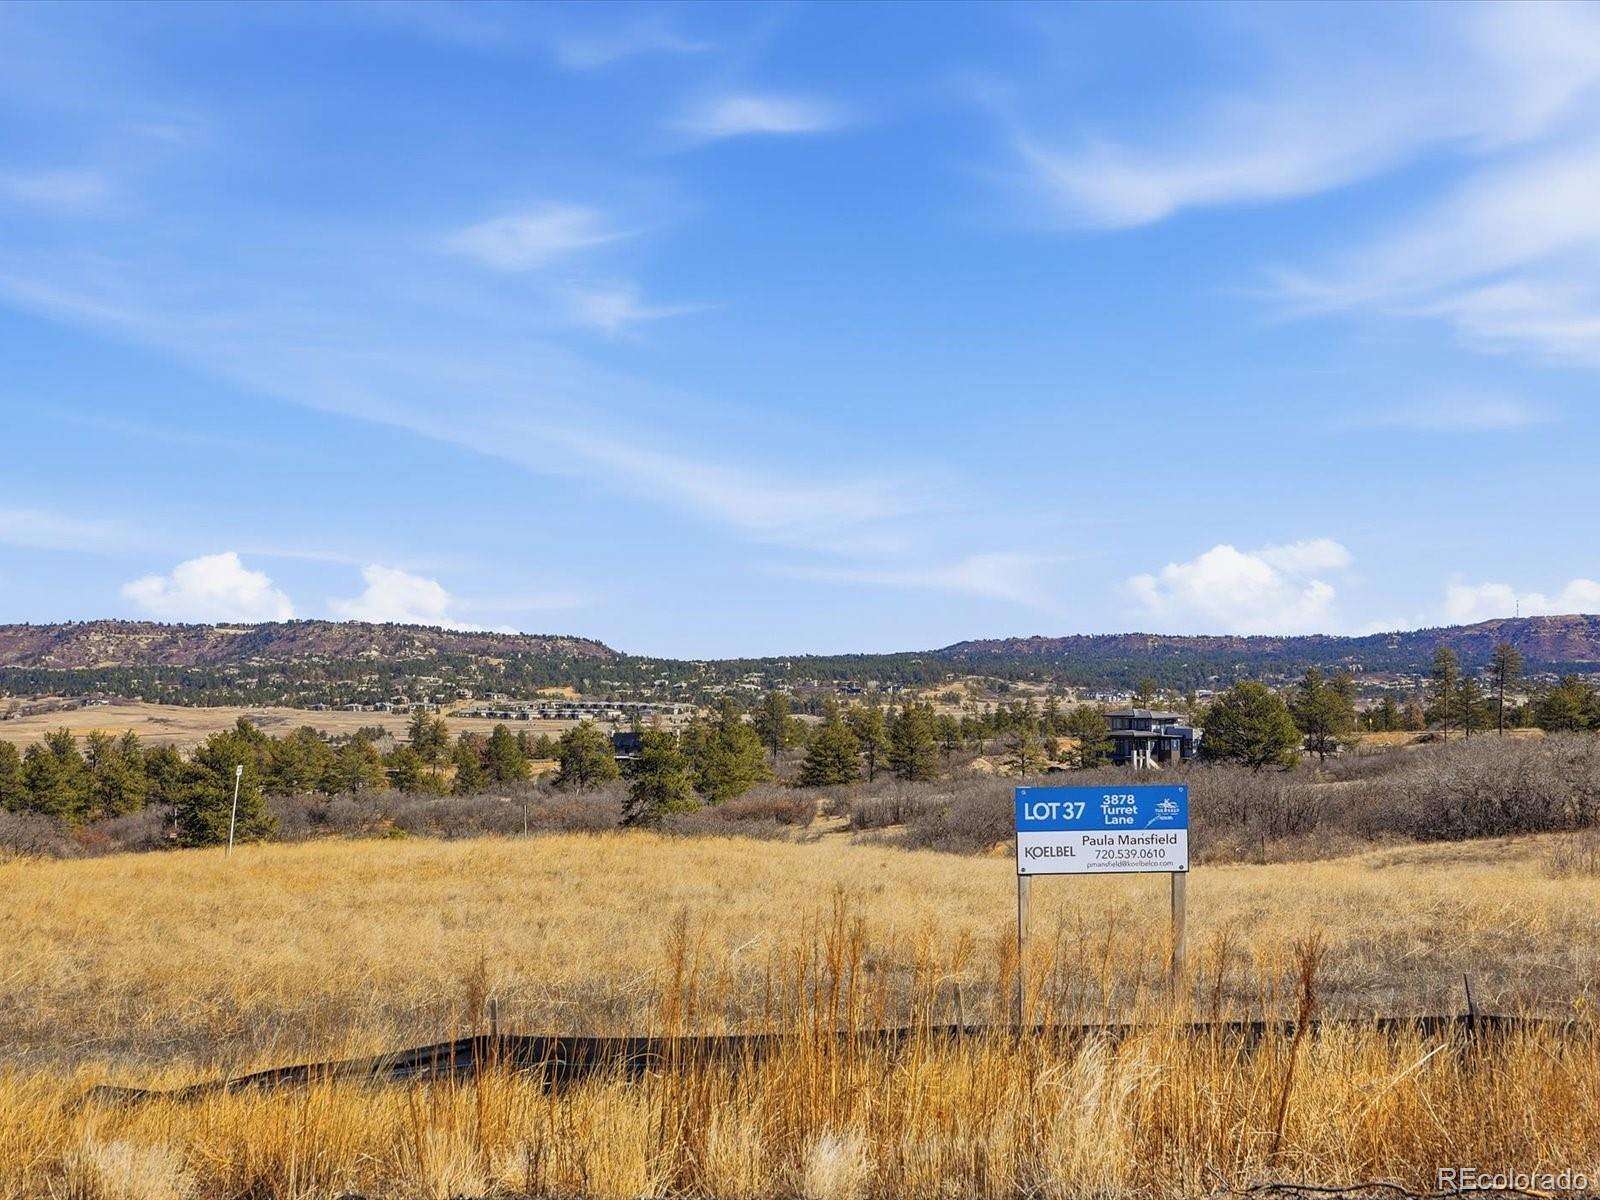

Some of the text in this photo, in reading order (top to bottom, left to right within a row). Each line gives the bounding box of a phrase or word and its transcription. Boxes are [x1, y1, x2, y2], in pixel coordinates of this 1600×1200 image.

[1102, 795, 1135, 805] 3878
[1025, 802, 1085, 821] LOT 37
[1101, 805, 1138, 815] Turret
[1105, 815, 1134, 825] Lane
[1082, 834, 1177, 846] Paula Mansfield
[1025, 846, 1076, 860] KOELBEL
[1095, 849, 1165, 860] 720.539.0610
[1086, 860, 1174, 869] pmansfield@koelbelco.com
